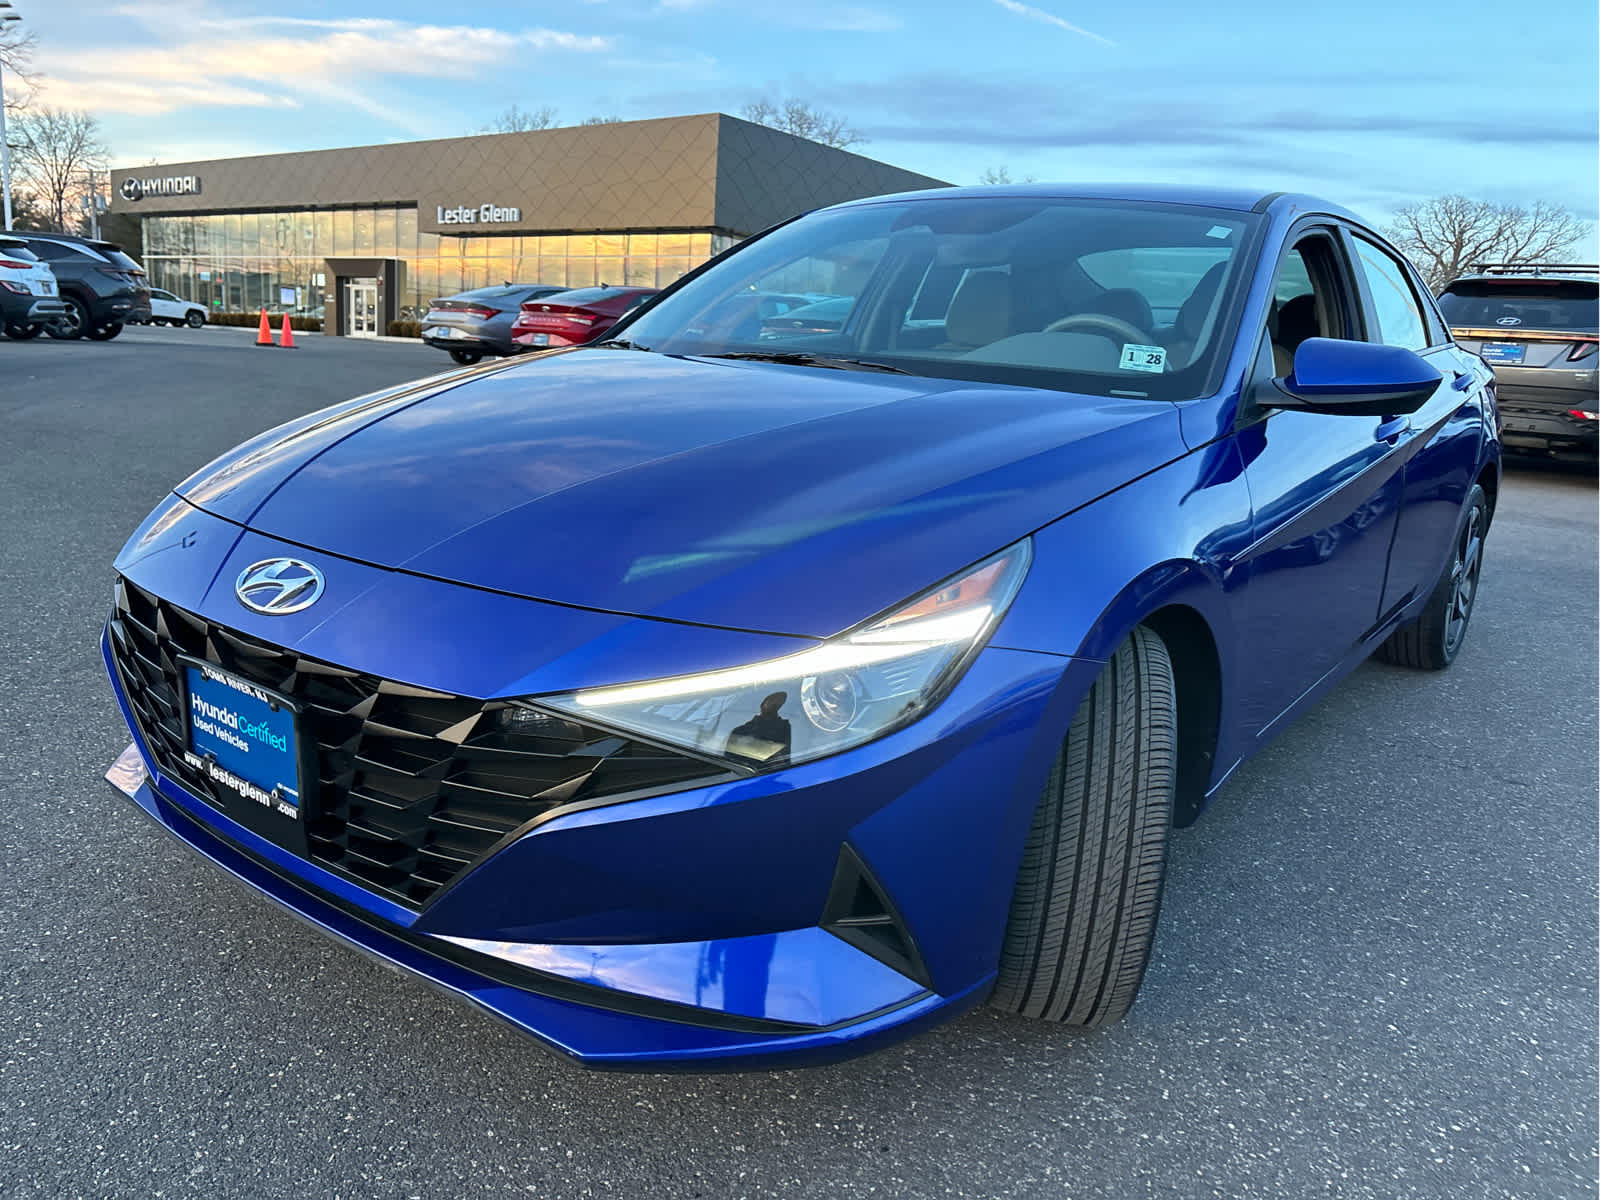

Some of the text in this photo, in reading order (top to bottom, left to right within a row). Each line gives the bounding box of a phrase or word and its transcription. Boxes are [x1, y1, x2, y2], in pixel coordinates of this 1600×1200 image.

[142, 176, 197, 194] HYUNDAI
[437, 203, 520, 224] Lester Glenn
[1127, 352, 1162, 365] 1 28
[202, 665, 227, 685] TOMS
[254, 688, 269, 703] NJ
[191, 693, 287, 752] Hyundai Certified
[193, 715, 249, 753] Used Vehicles
[184, 751, 203, 770] www.
[209, 762, 270, 807] lesterglenn
[277, 803, 297, 820] .com
